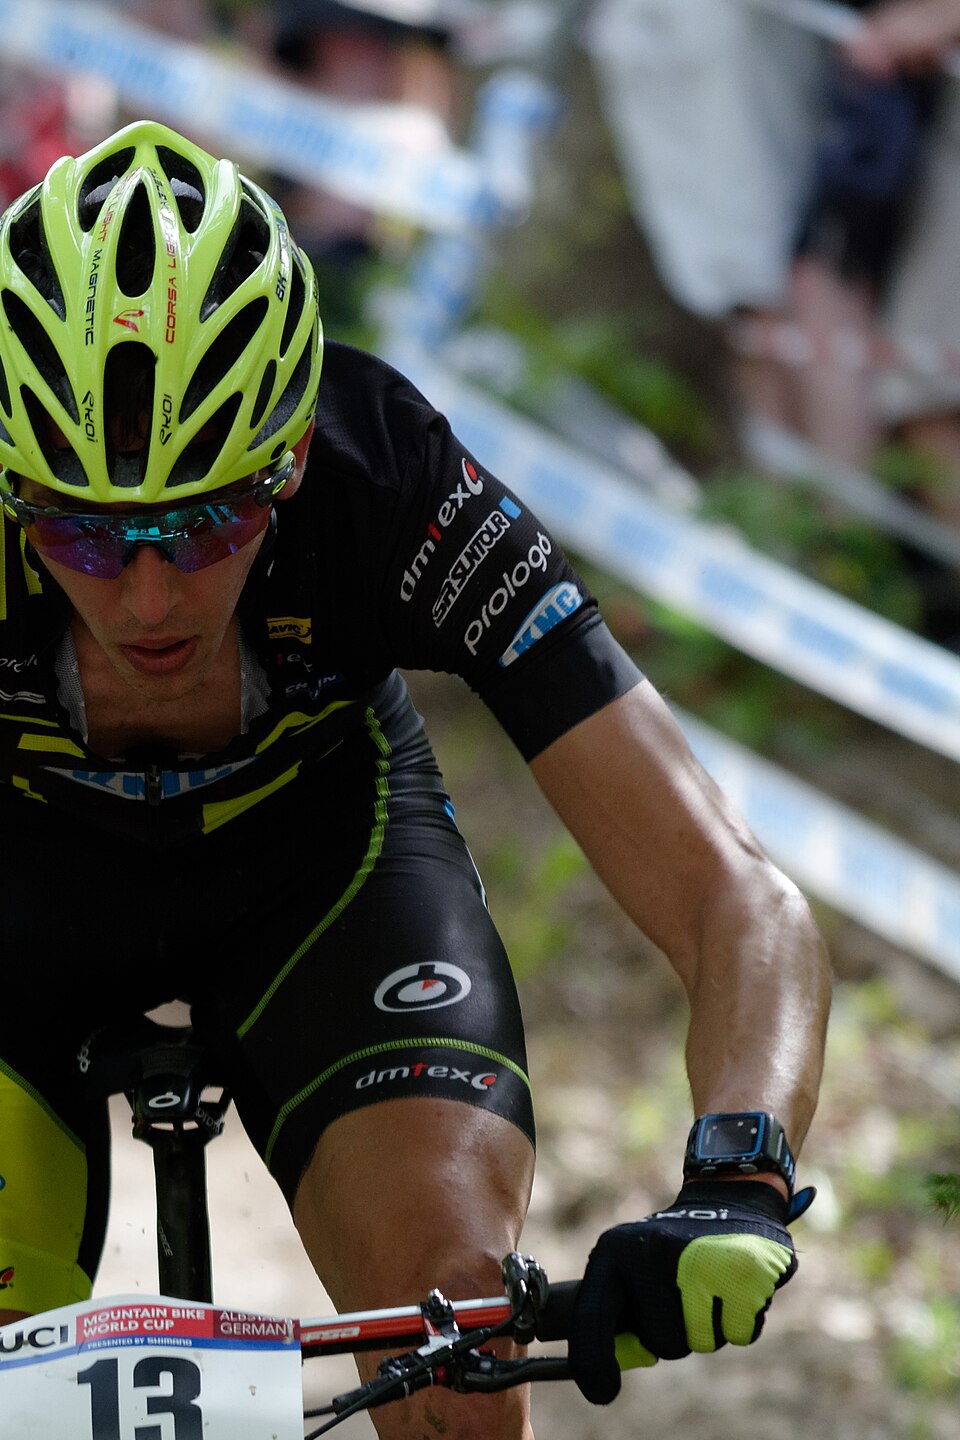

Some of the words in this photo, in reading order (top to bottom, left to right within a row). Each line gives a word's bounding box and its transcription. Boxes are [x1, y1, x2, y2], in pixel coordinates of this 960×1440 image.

[85, 248, 102, 346] MAGNETIC
[165, 276, 178, 344] CORSA
[464, 532, 552, 656] prologo
[512, 589, 577, 655] KMC
[83, 1307, 168, 1328] MOUNTAIN
[171, 1308, 206, 1320] BIKE
[83, 1319, 143, 1338] WORLD
[146, 1319, 175, 1332] CUP
[220, 1322, 295, 1337] GERMANY
[87, 1337, 132, 1350] PRESENTED
[134, 1337, 145, 1346] BY
[147, 1336, 193, 1347] SHIMANO
